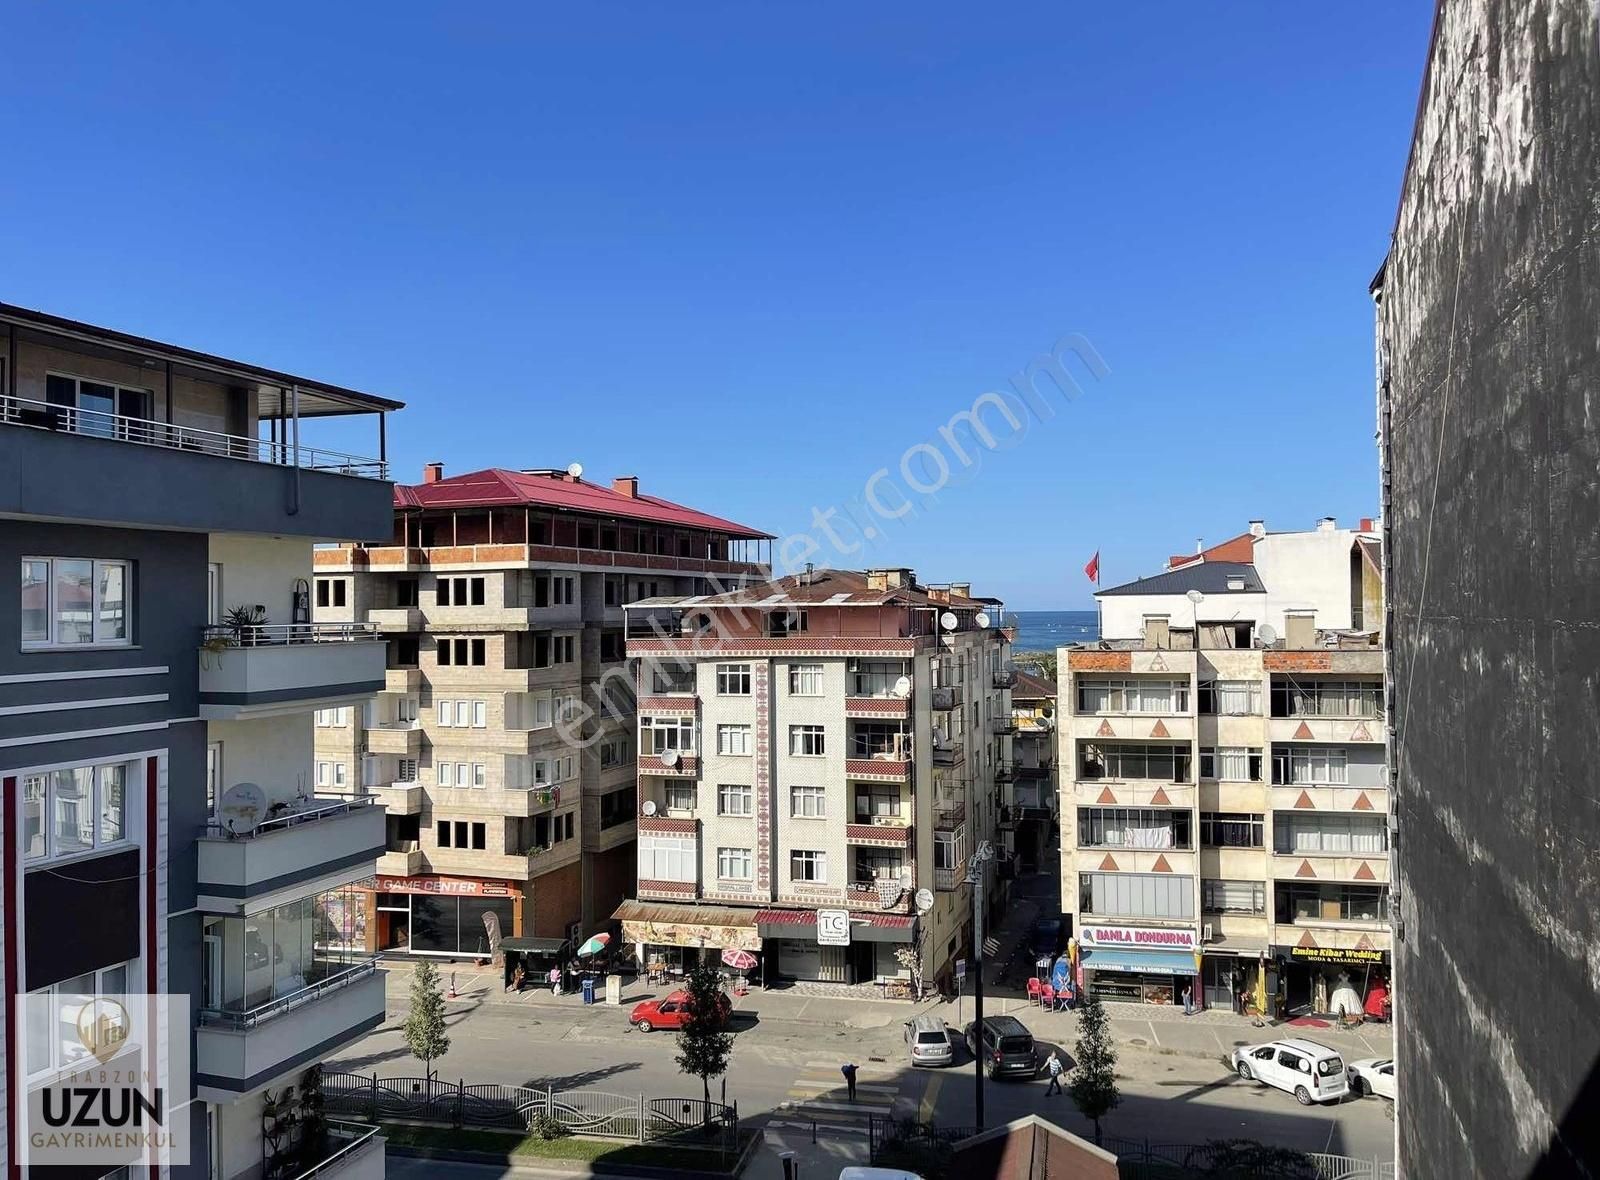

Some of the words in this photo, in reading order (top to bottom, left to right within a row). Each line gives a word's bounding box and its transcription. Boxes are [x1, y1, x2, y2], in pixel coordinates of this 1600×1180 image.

[383, 879, 421, 889] GAME
[424, 881, 477, 892] CENTER
[1096, 929, 1132, 942] DAMLA
[1134, 931, 1192, 945] DONDURMA
[1292, 947, 1318, 956] Emine
[1319, 948, 1344, 957] Kibar
[1345, 950, 1382, 960] Wedding
